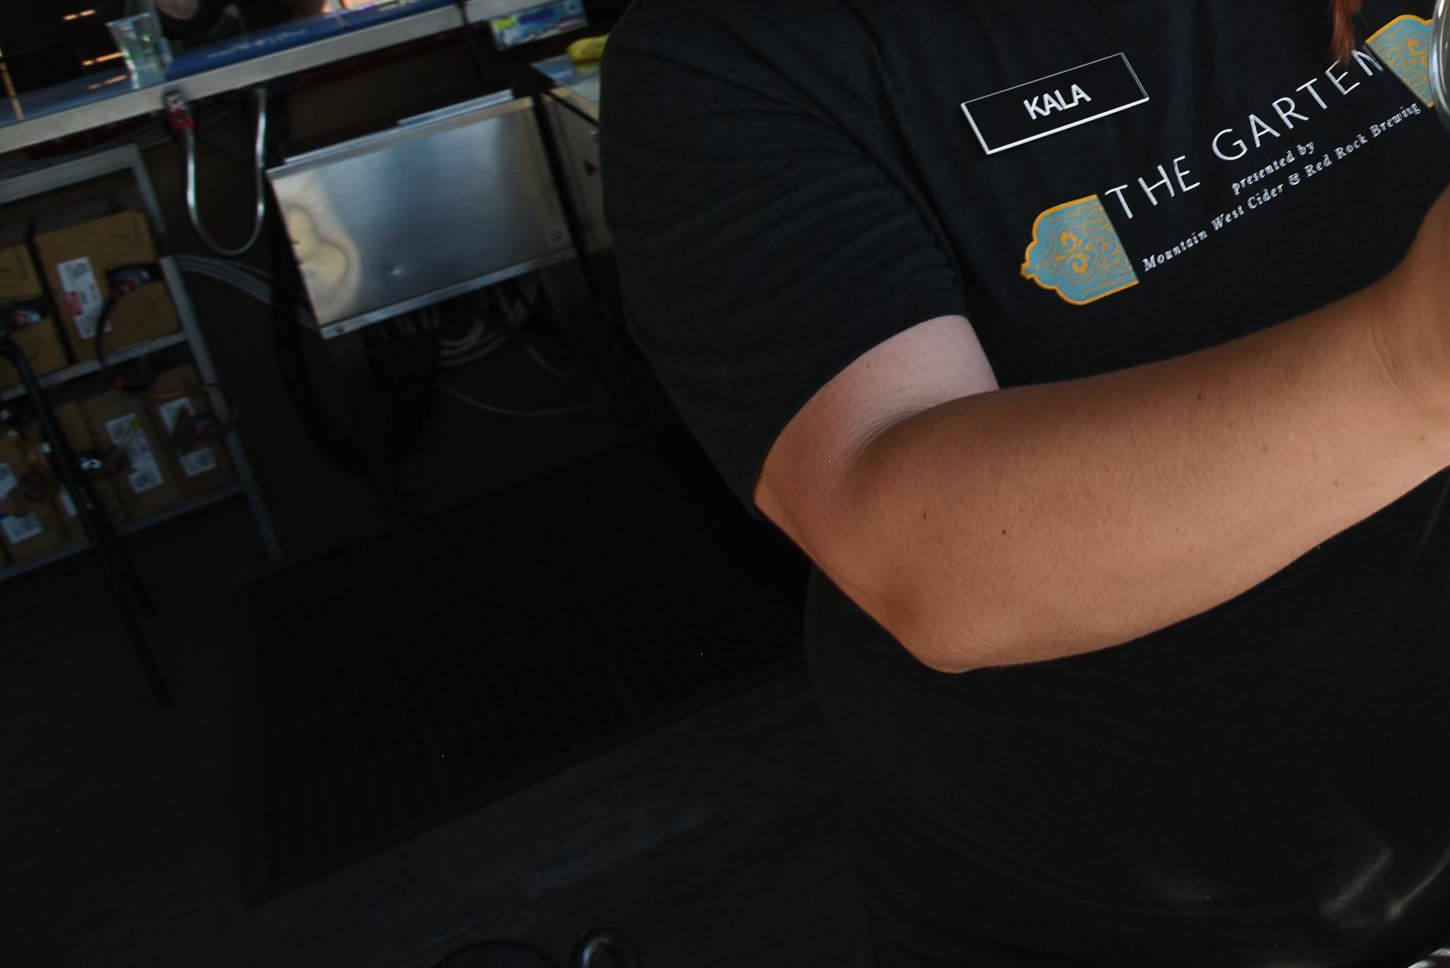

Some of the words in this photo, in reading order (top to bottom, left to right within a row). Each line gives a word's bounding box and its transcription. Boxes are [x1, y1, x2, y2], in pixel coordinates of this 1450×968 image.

[1023, 83, 1092, 120] KALA
[1104, 154, 1200, 220] THE
[1211, 45, 1384, 162] GARTEN
[1142, 229, 1208, 272] Mountain
[1211, 205, 1244, 231] West
[1247, 182, 1284, 209] Cider
[1288, 172, 1301, 186] &
[1304, 154, 1332, 178] Red
[1334, 133, 1368, 160] Rock
[1370, 102, 1422, 138] Brewing
[1231, 150, 1295, 196] presented
[1297, 140, 1315, 156] by
